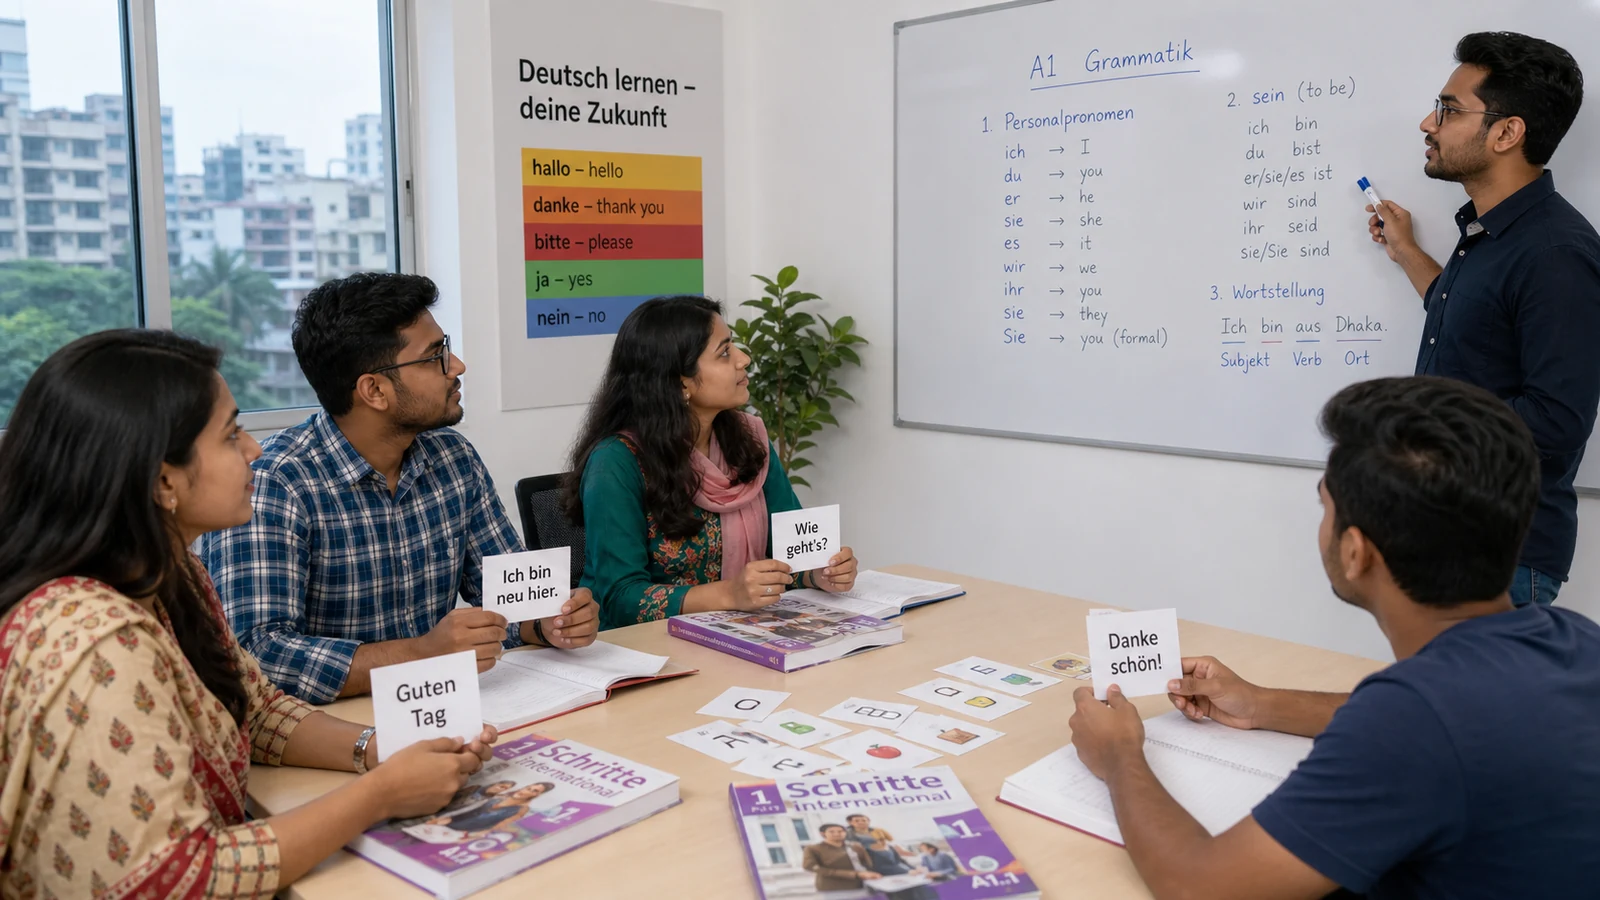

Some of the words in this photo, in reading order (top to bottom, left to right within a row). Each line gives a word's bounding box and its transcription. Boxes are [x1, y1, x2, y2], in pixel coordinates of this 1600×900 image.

[1030, 54, 1057, 80] A1
[1085, 39, 1193, 73] Grammatik
[519, 58, 608, 90] Deutsch
[615, 68, 678, 95] lernen
[1227, 92, 1241, 107] 2.
[1252, 88, 1285, 105] sein
[1297, 80, 1322, 103] (to
[1329, 75, 1356, 99] be)
[520, 96, 580, 122] deine
[587, 101, 667, 128] Zukunft
[982, 116, 993, 133] 1.
[1005, 108, 1134, 132] Personalpronomen
[1248, 118, 1269, 135] ich
[1295, 115, 1318, 131] bin
[1005, 143, 1025, 159] ich
[1081, 138, 1090, 155] I
[1245, 143, 1265, 160] du
[1293, 139, 1321, 157] bist
[532, 158, 571, 177] hallo
[588, 161, 623, 178] hello
[1004, 167, 1022, 183] du
[1079, 168, 1103, 185] you
[1244, 166, 1305, 188] er/sie/es
[1313, 164, 1333, 181] ist
[533, 196, 580, 213] danke
[597, 198, 636, 214] thank
[640, 202, 664, 218] you
[1004, 194, 1020, 206] er
[1079, 189, 1095, 203] he
[1243, 198, 1267, 211] wir
[1288, 191, 1317, 209] sind
[1004, 214, 1024, 228] sie
[1079, 211, 1103, 227] she
[1243, 219, 1265, 235] ihr
[1288, 216, 1318, 233] seid
[534, 233, 570, 250] bitte
[588, 235, 633, 253] please
[1004, 238, 1020, 250] es
[1080, 235, 1092, 250] it
[1240, 241, 1289, 262] sie/Sie
[1300, 240, 1330, 258] sind
[1003, 260, 1026, 273] wir
[1079, 262, 1098, 274] we
[535, 270, 549, 292] ja
[568, 273, 593, 291] yes
[1004, 281, 1025, 296] ihr
[1079, 286, 1102, 303] you
[1210, 285, 1223, 301] 3.
[1232, 281, 1325, 306] Wortstellung
[537, 309, 570, 326] nein
[588, 310, 606, 323] no
[1004, 306, 1025, 320] sie
[1079, 306, 1108, 327] they
[1221, 317, 1247, 335] Ich
[1261, 317, 1283, 334] bin
[1295, 320, 1321, 333] aus
[1336, 315, 1388, 333] Dhaka.
[1003, 327, 1026, 345] Sie
[1080, 334, 1104, 351] you
[1113, 327, 1168, 348] (formal)
[1220, 351, 1270, 374] Subjekt
[1293, 351, 1322, 366] Verb
[1344, 350, 1370, 366] Ort
[795, 521, 819, 535] Wie
[786, 537, 828, 559] geht's?
[503, 570, 524, 584] Ich
[529, 565, 551, 580] bin
[497, 591, 524, 605] neu
[528, 586, 558, 600] hier.
[1108, 630, 1158, 649] Danke
[1111, 653, 1162, 675] schön!
[396, 679, 456, 702] Guten
[411, 708, 447, 728] Tag
[514, 756, 623, 798] international
[538, 745, 646, 789] Schritte
[786, 773, 944, 799] Schritte
[750, 789, 772, 805] 1
[793, 790, 952, 813] international
[951, 818, 982, 839] 1
